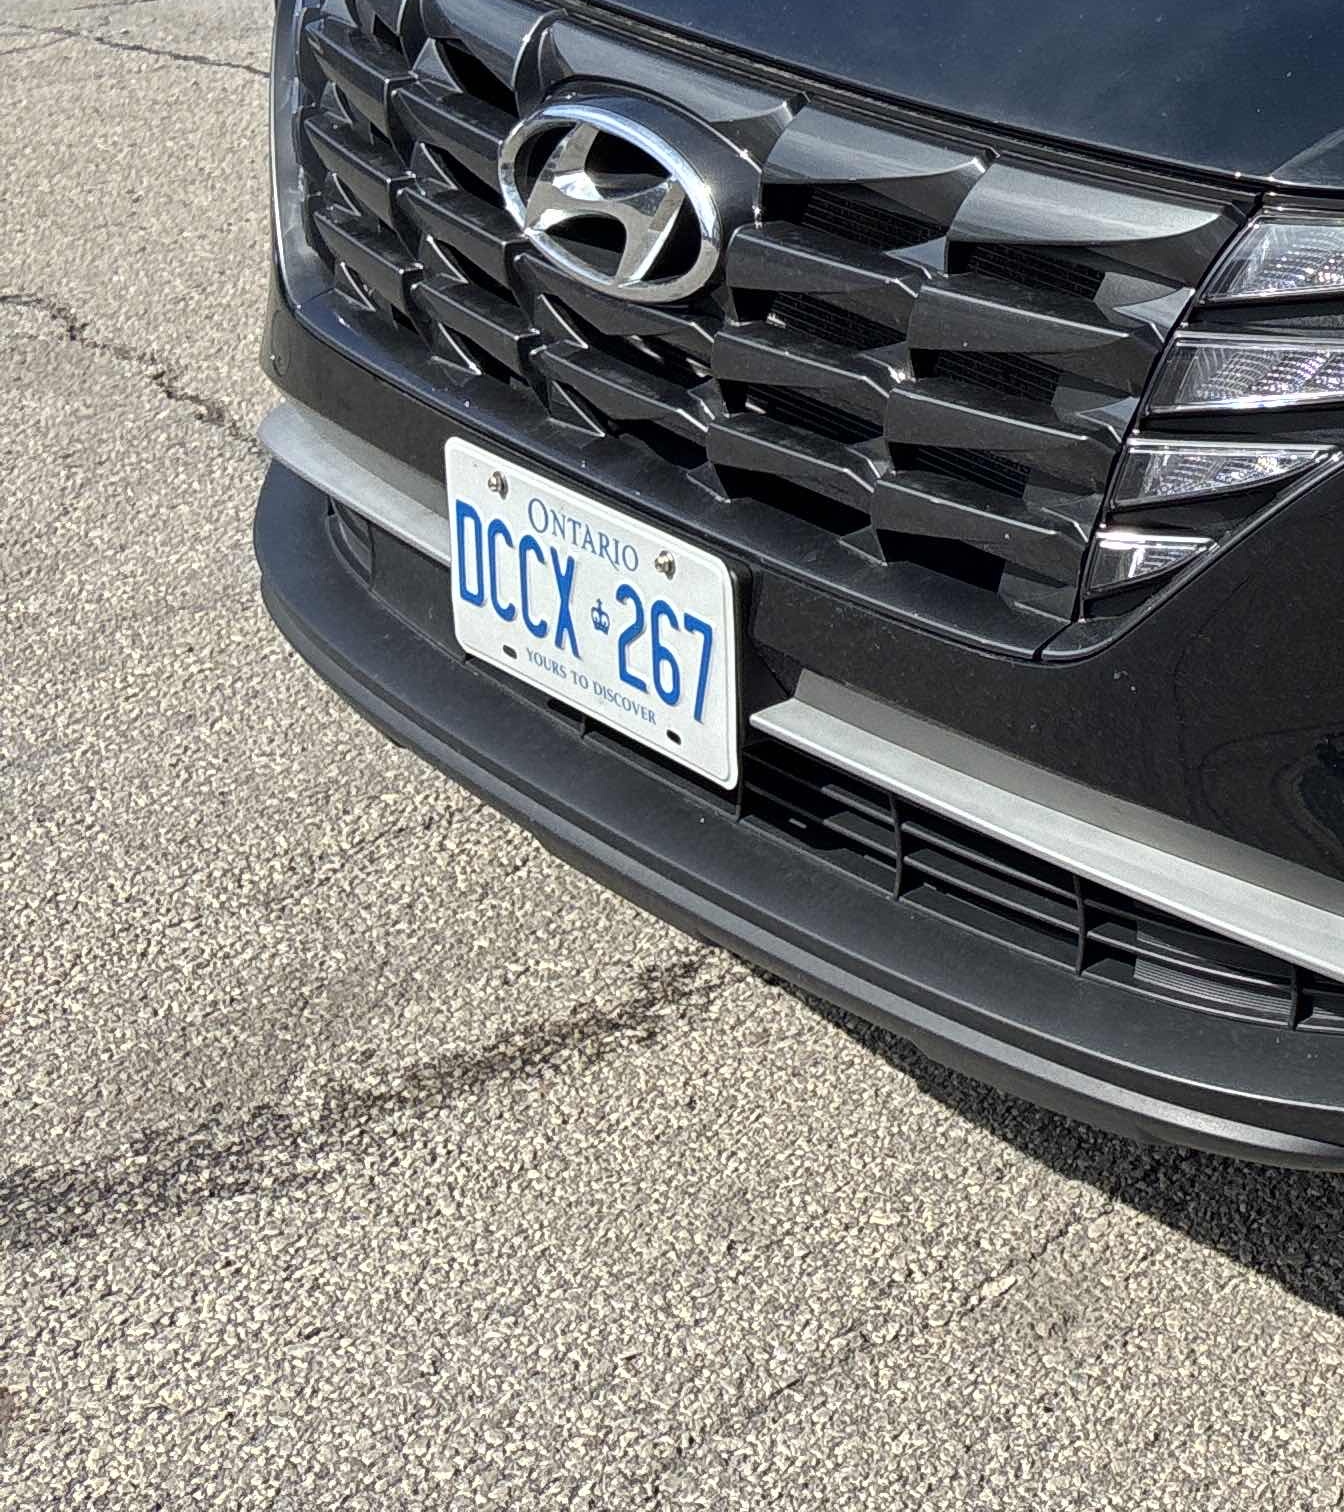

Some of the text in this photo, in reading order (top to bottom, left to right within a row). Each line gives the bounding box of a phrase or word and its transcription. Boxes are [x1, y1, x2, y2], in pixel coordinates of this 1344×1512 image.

[528, 498, 639, 572] ONTARIO
[456, 498, 713, 724] DCCX 267
[526, 647, 657, 724] YOURS TO DISCOVER
